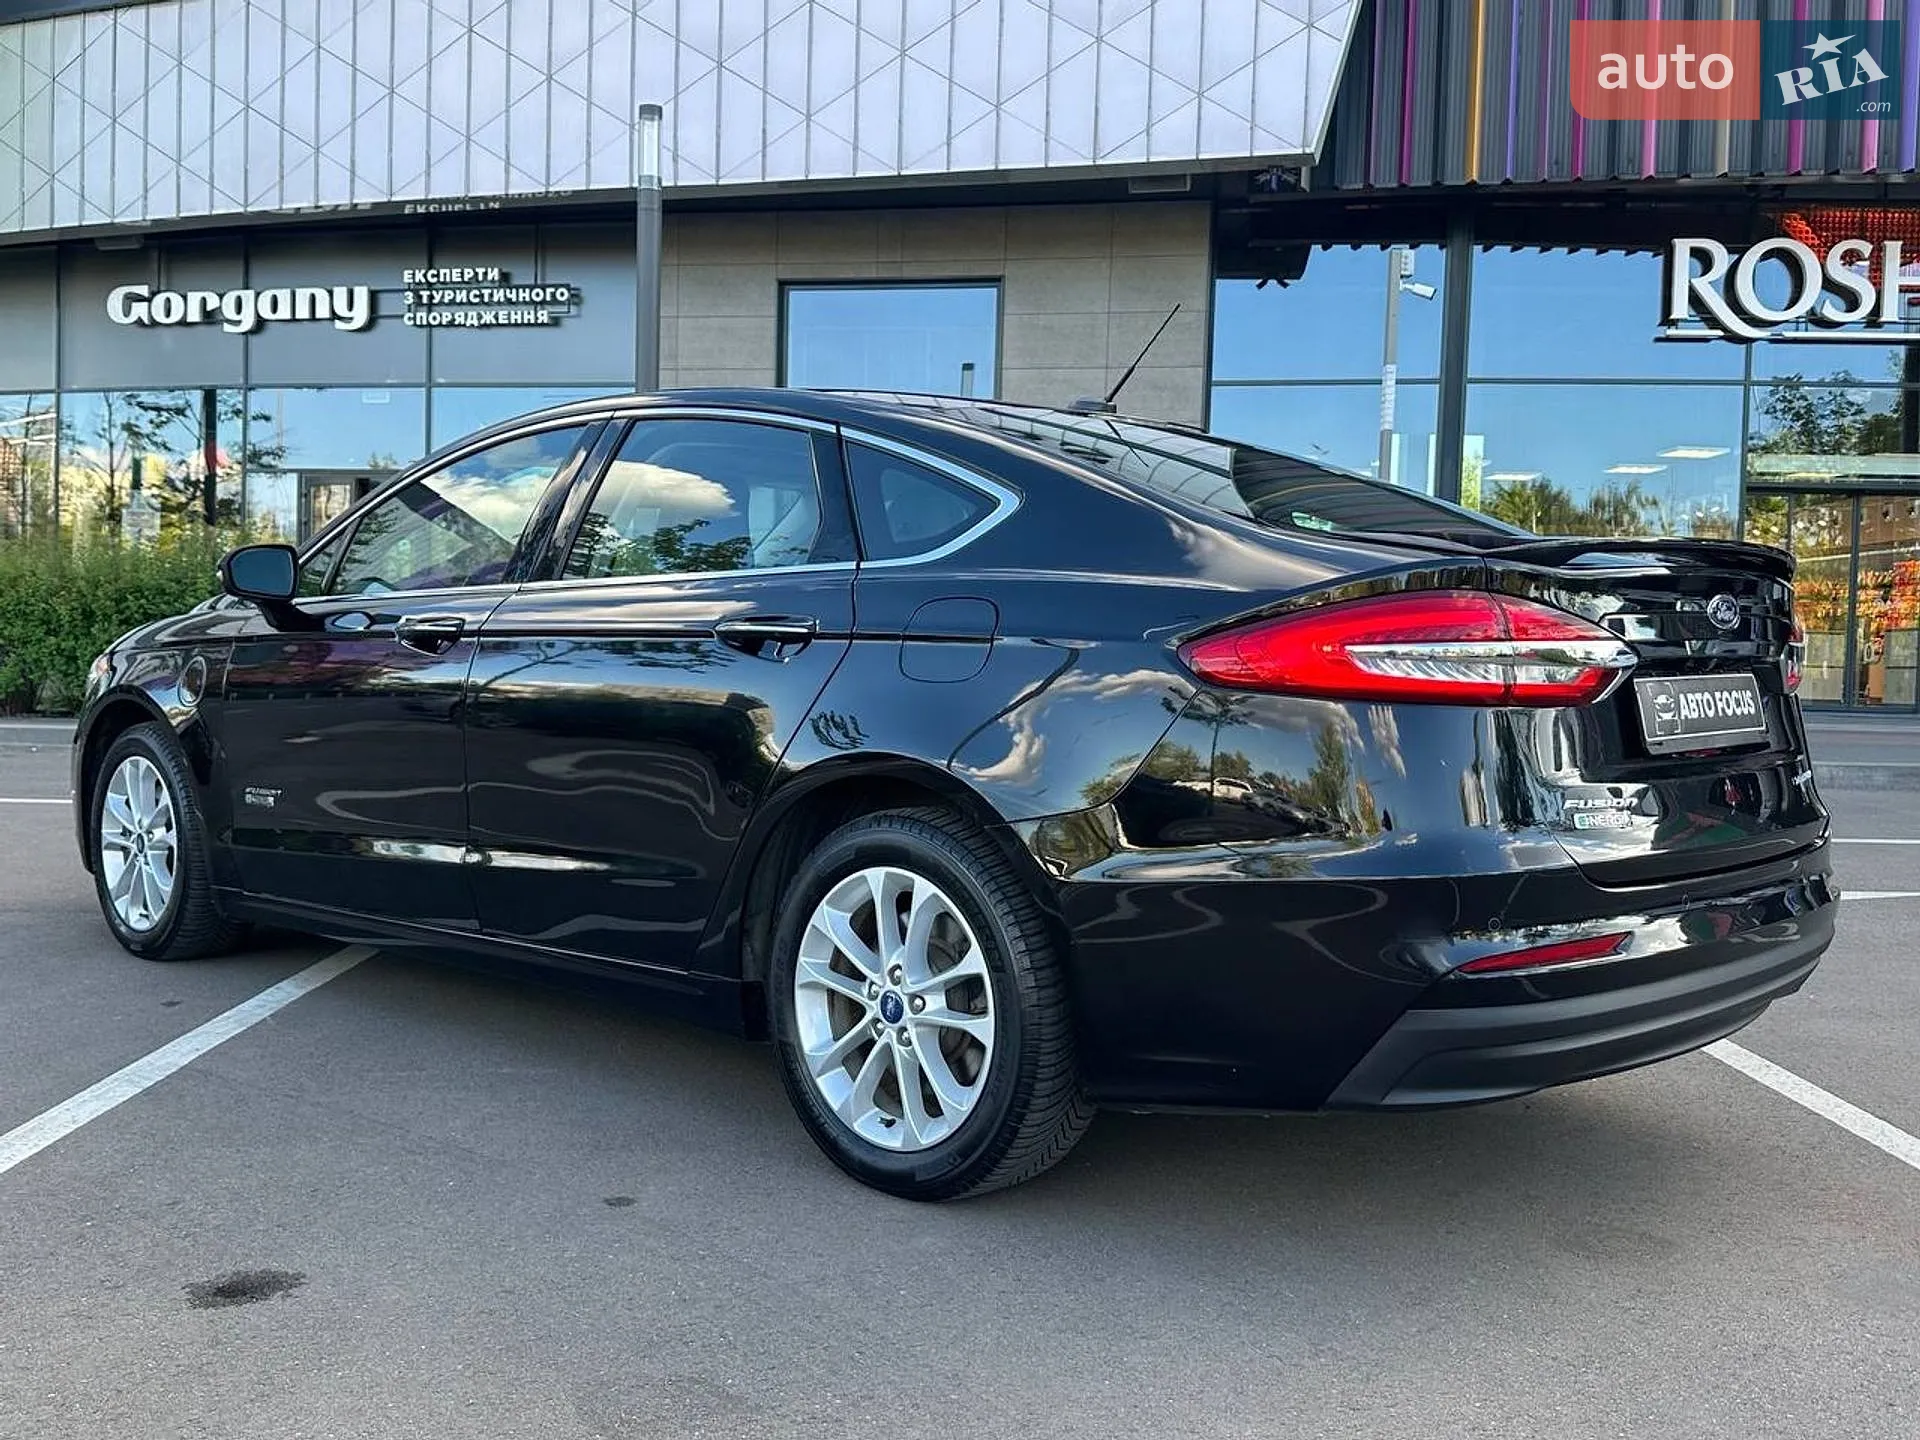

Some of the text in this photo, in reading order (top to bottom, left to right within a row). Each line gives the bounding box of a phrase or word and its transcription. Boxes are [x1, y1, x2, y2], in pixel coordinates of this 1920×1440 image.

[403, 267, 499, 283] ЕКСПЕРТИ
[419, 287, 569, 304] ТУРИСТИЧНОГО
[106, 284, 371, 334] Gorgany
[403, 310, 549, 327] СПОРЯДЖЕННЯ
[1714, 690, 1755, 716] FOCUS
